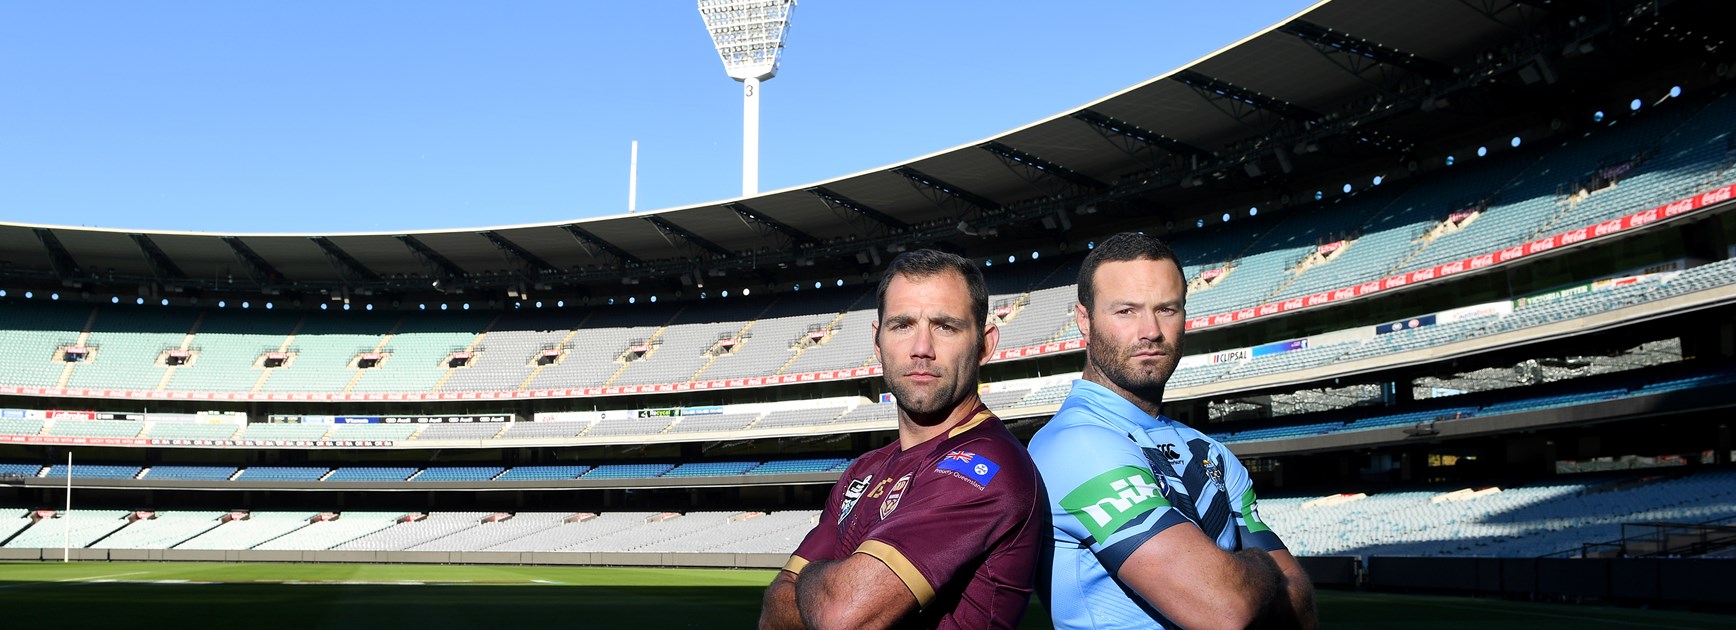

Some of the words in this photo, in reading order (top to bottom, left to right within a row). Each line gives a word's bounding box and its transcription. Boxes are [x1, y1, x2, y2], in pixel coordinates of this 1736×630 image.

[745, 84, 754, 98] 3
[1471, 254, 1493, 268] Coca-Cola
[1500, 246, 1523, 261] Coca-Cola
[1530, 238, 1554, 253] Coca-Cola
[1562, 228, 1587, 245] Coca-Cola
[1595, 219, 1622, 236] Coca-Cola
[1630, 209, 1658, 226] Coca-Cola
[1665, 199, 1693, 216] Coca-Cola
[1702, 186, 1732, 205] Coca-Cola
[1219, 350, 1247, 363] CLIPSAL
[953, 471, 986, 492] Queensland
